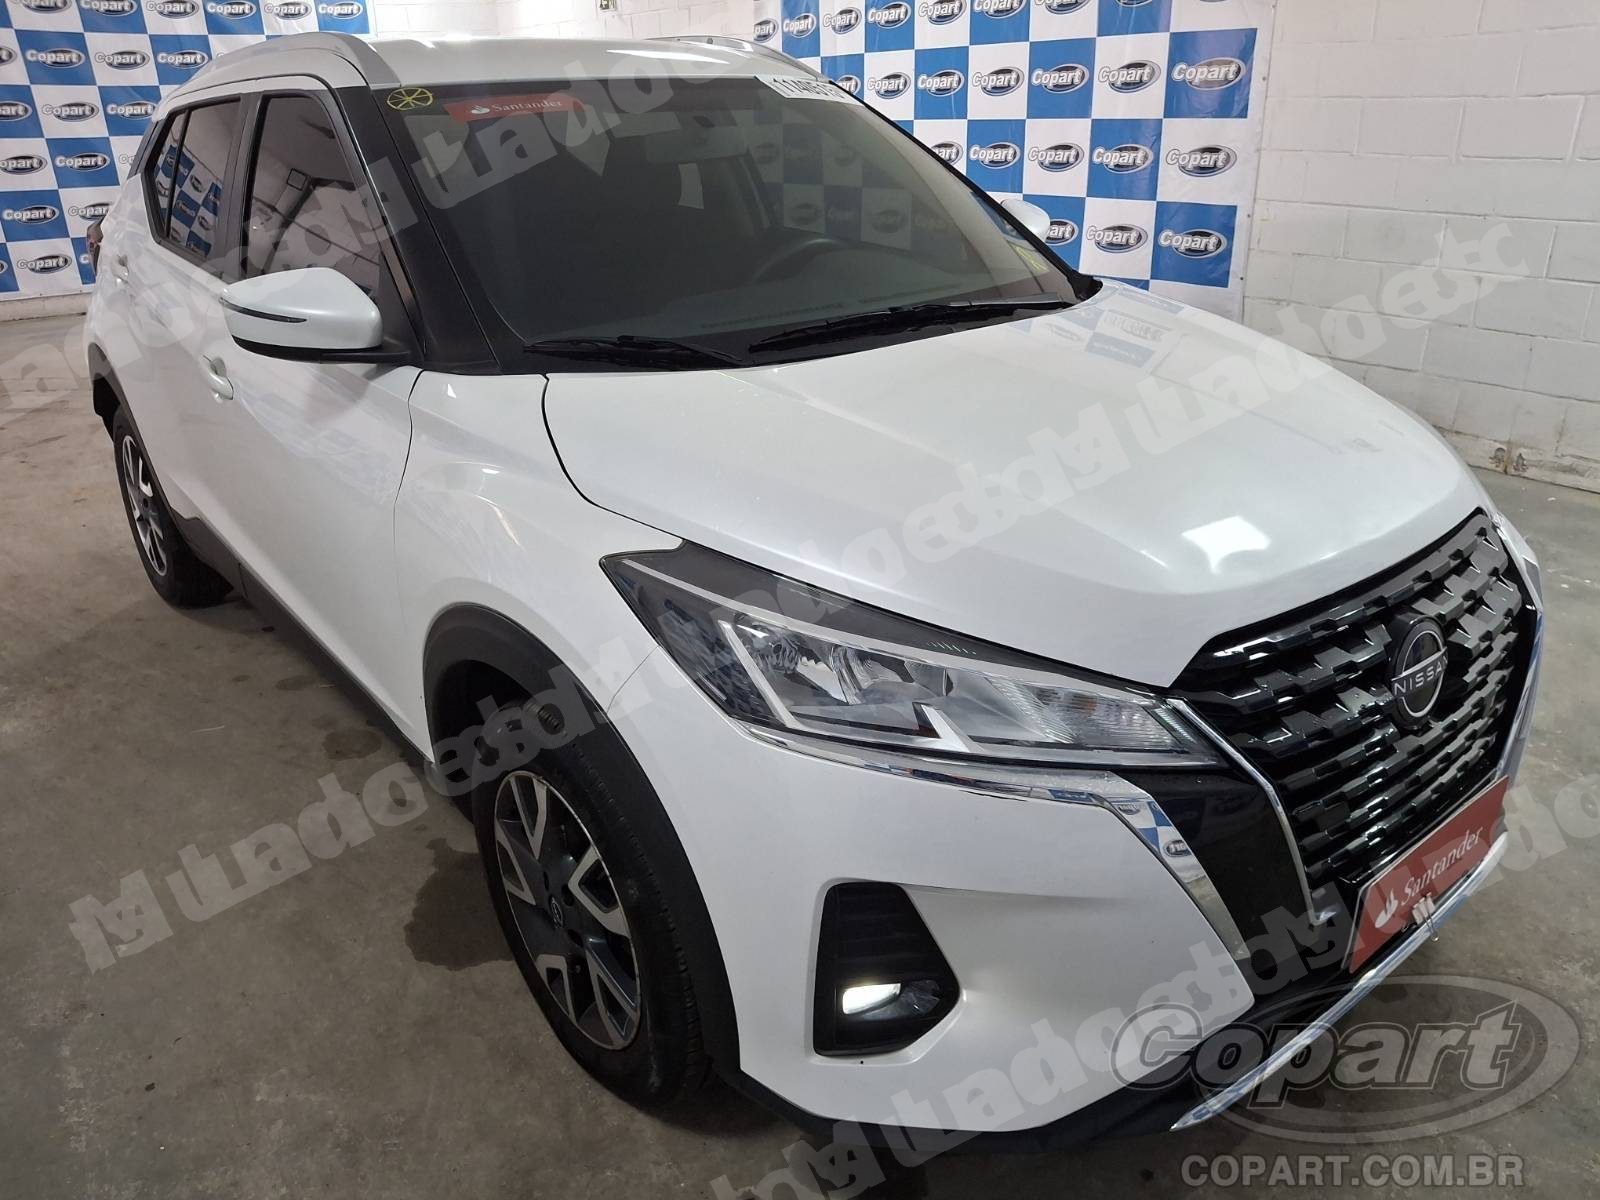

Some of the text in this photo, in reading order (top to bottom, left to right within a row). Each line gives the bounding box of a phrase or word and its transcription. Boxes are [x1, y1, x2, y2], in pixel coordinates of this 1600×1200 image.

[147, 0, 193, 14] Copart
[207, 2, 250, 15] Copart
[264, 4, 306, 16] Copart
[318, 3, 358, 15] Copart
[919, 0, 960, 18] Copart
[823, 12, 857, 30] Copart
[868, 8, 905, 25] Copart
[784, 17, 812, 35] Copart
[26, 50, 78, 65] Copart
[95, 53, 142, 67] Copart
[157, 53, 201, 66] Copart
[972, 71, 1018, 89] Copart
[1031, 67, 1081, 86] Copart
[1098, 65, 1150, 86] Copart
[1172, 61, 1236, 83] Copart
[868, 76, 905, 92] Copart
[918, 74, 957, 91] Copart
[42, 104, 92, 117] Copart
[106, 104, 153, 116] Copart
[492, 99, 562, 112] Santander
[969, 144, 1014, 162] Copart
[1028, 146, 1076, 164] Copart
[1092, 146, 1143, 166] Copart
[1166, 149, 1225, 170] Copart
[0, 158, 39, 171] opart
[55, 155, 102, 169] Copart
[3, 207, 52, 222] Copart
[68, 206, 108, 218] Copar
[1086, 225, 1138, 245] Copart
[1158, 228, 1218, 251] Copart
[17, 256, 64, 271] Copart
[1394, 654, 1448, 695] NISSAN
[1400, 826, 1483, 905] Santander
